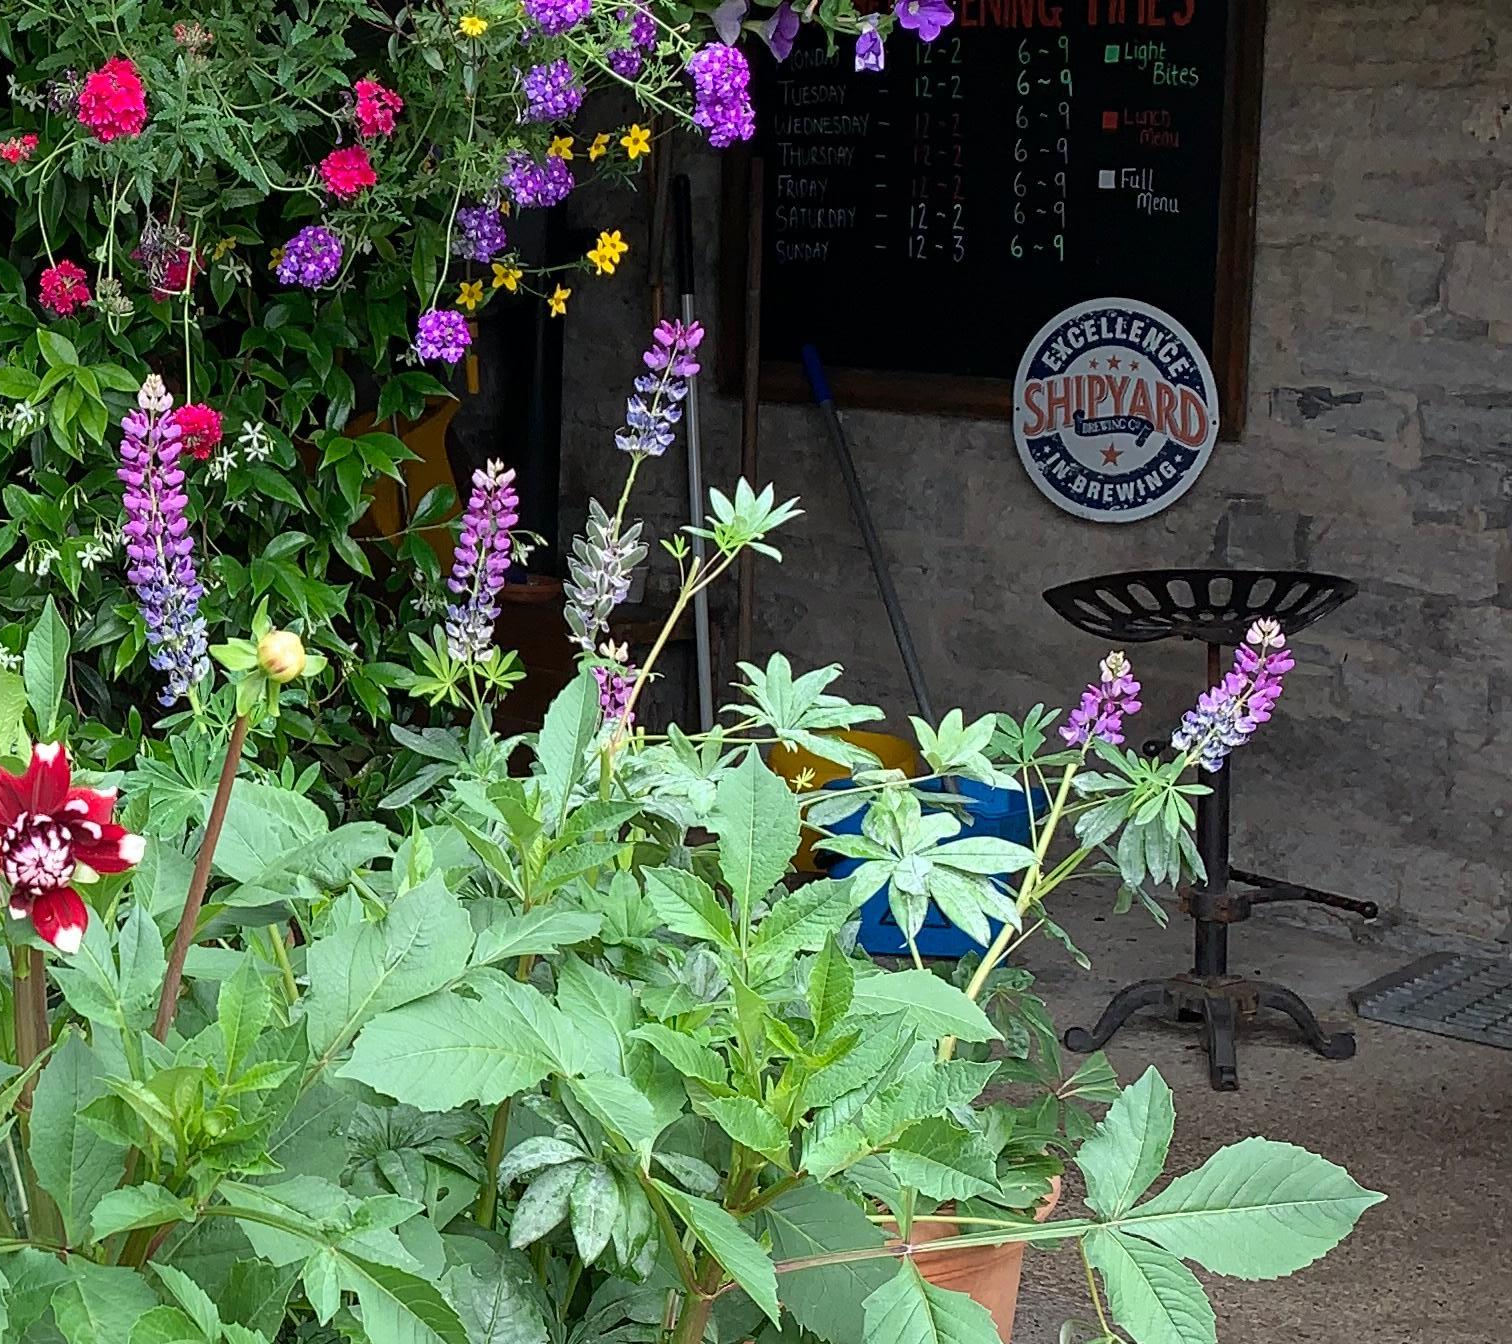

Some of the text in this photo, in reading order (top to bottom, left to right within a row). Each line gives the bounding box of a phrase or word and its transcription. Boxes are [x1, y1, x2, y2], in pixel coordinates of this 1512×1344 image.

[1124, 40, 1167, 70] Light
[1153, 62, 1199, 87] Bites
[776, 80, 846, 106] TUESDAY
[774, 112, 870, 136] WEDNESDAY
[777, 175, 828, 202] FRIDAY
[1121, 168, 1154, 191] Full
[1137, 192, 1180, 215] Menu
[776, 206, 856, 232] SATURDAY
[776, 240, 829, 263] SUNDAY
[1041, 316, 1194, 378] EXCELLENCE
[1023, 374, 1208, 447] SHIPYARD
[1045, 452, 1178, 503] IN BREWING
